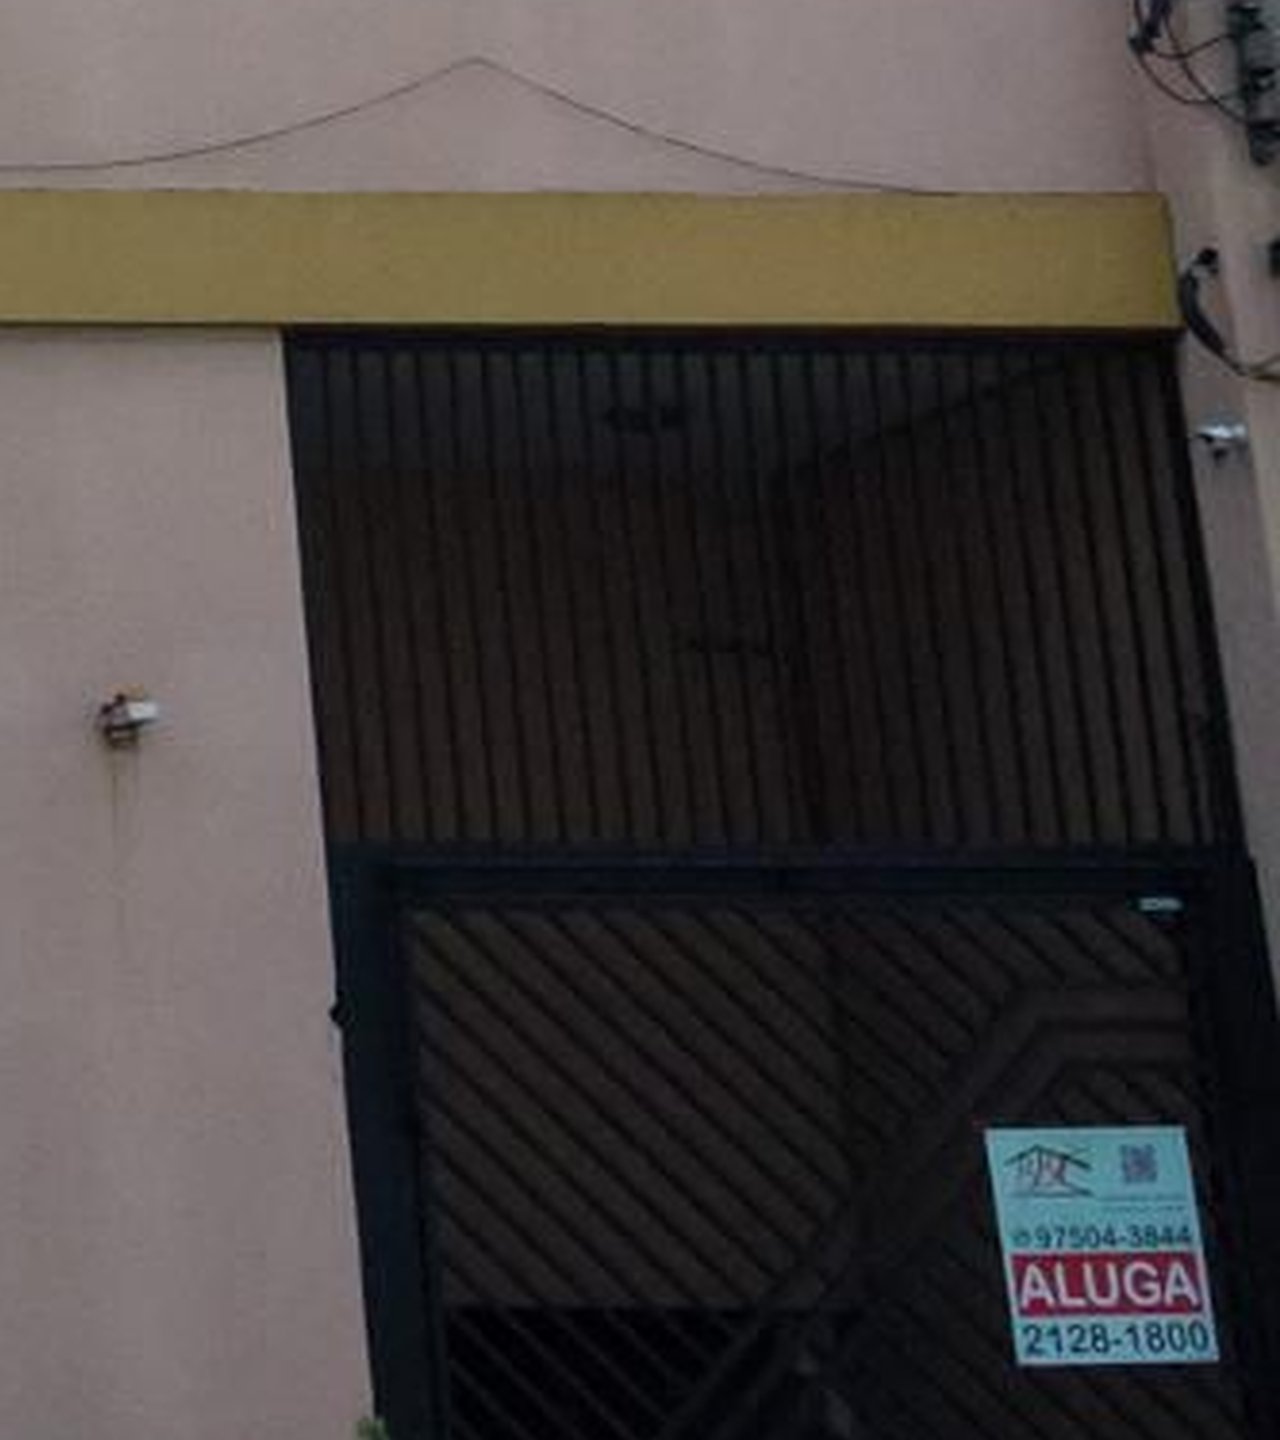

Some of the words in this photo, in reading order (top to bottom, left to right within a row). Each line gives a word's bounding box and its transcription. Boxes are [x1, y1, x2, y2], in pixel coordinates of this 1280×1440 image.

[1037, 1223, 1191, 1250] 97504-3844
[1021, 1260, 1199, 1309] ALUGA
[1023, 1322, 1209, 1355] 2128-1800
